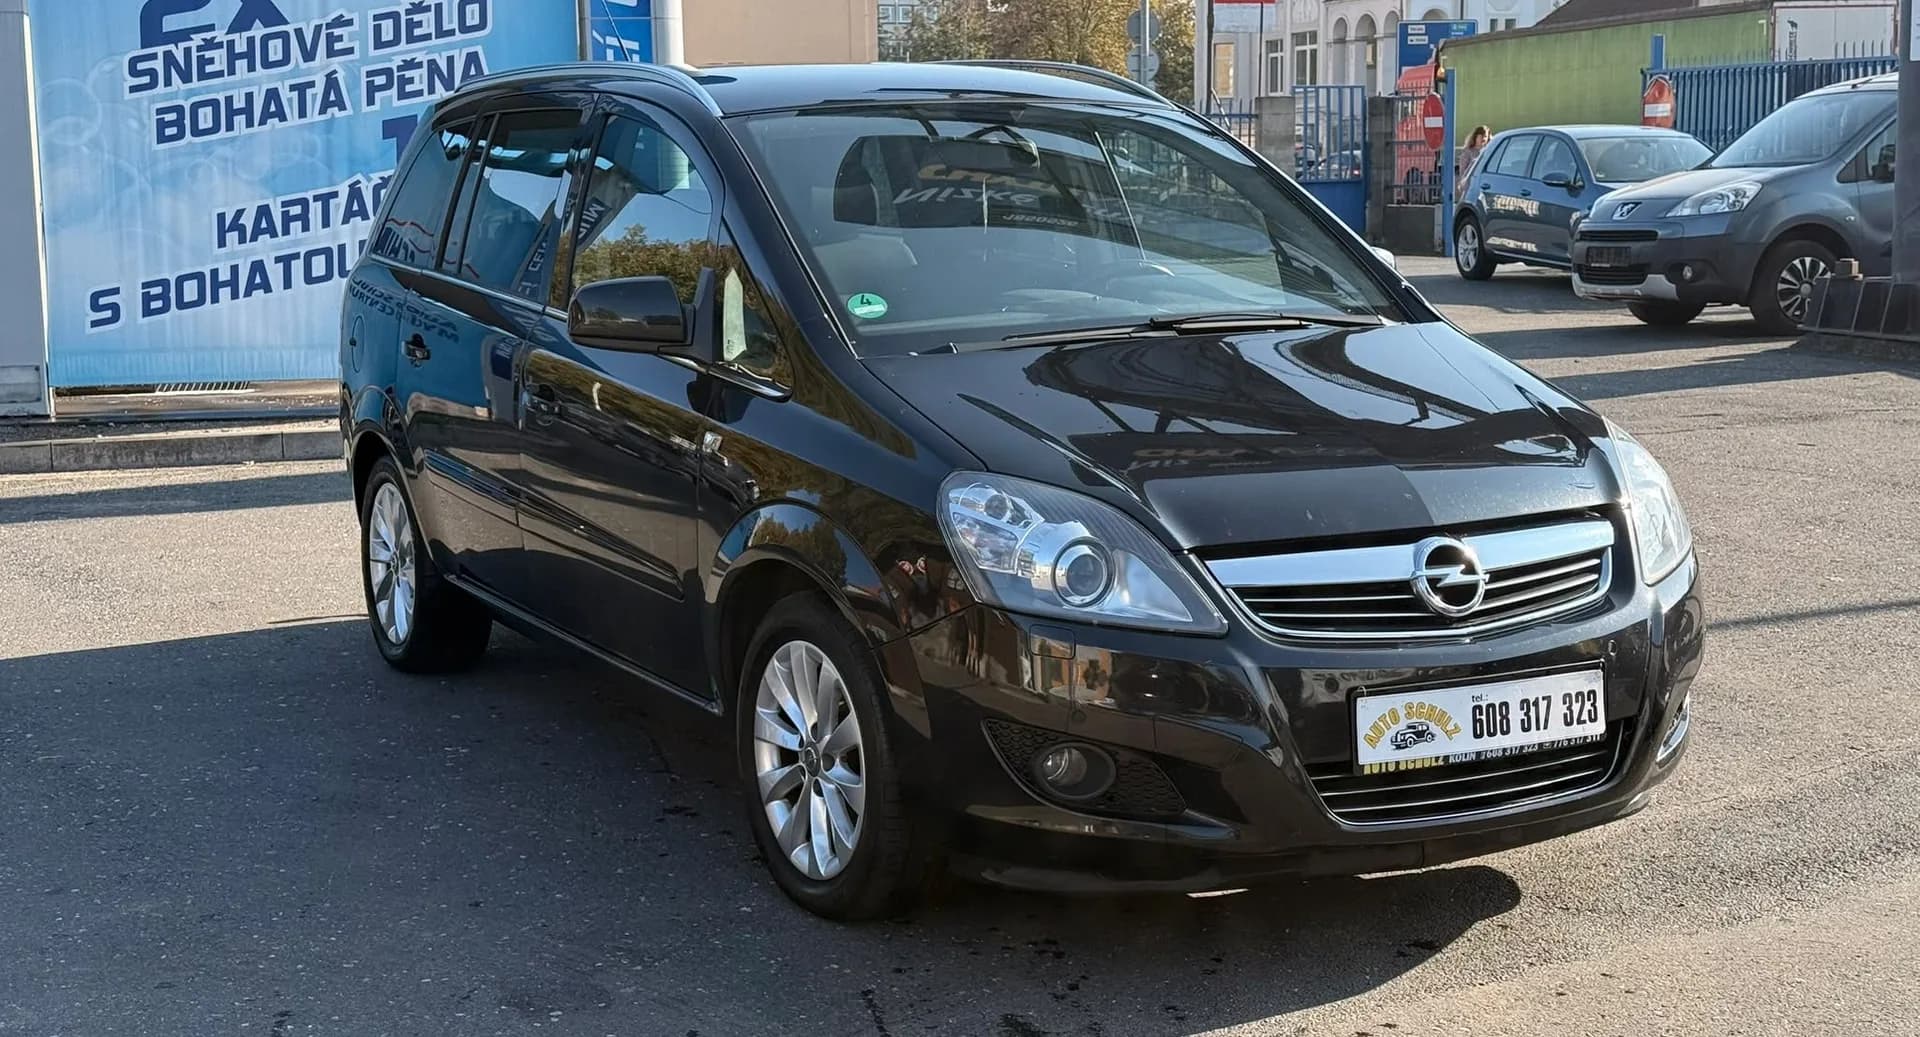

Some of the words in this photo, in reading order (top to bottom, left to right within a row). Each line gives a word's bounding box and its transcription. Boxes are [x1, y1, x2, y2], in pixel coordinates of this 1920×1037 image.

[128, 13, 355, 94] SNĚHOVÉ
[372, 0, 488, 51] DĚLO
[155, 69, 348, 145] BOHATÁ
[365, 50, 487, 108] PĚNA
[89, 286, 121, 329] S
[860, 294, 872, 306] 4
[1363, 707, 1401, 750] AUTO
[1404, 701, 1462, 741] SCHULZ
[1471, 701, 1511, 739] 608
[1520, 695, 1552, 733] 317
[1562, 689, 1598, 727] 323
